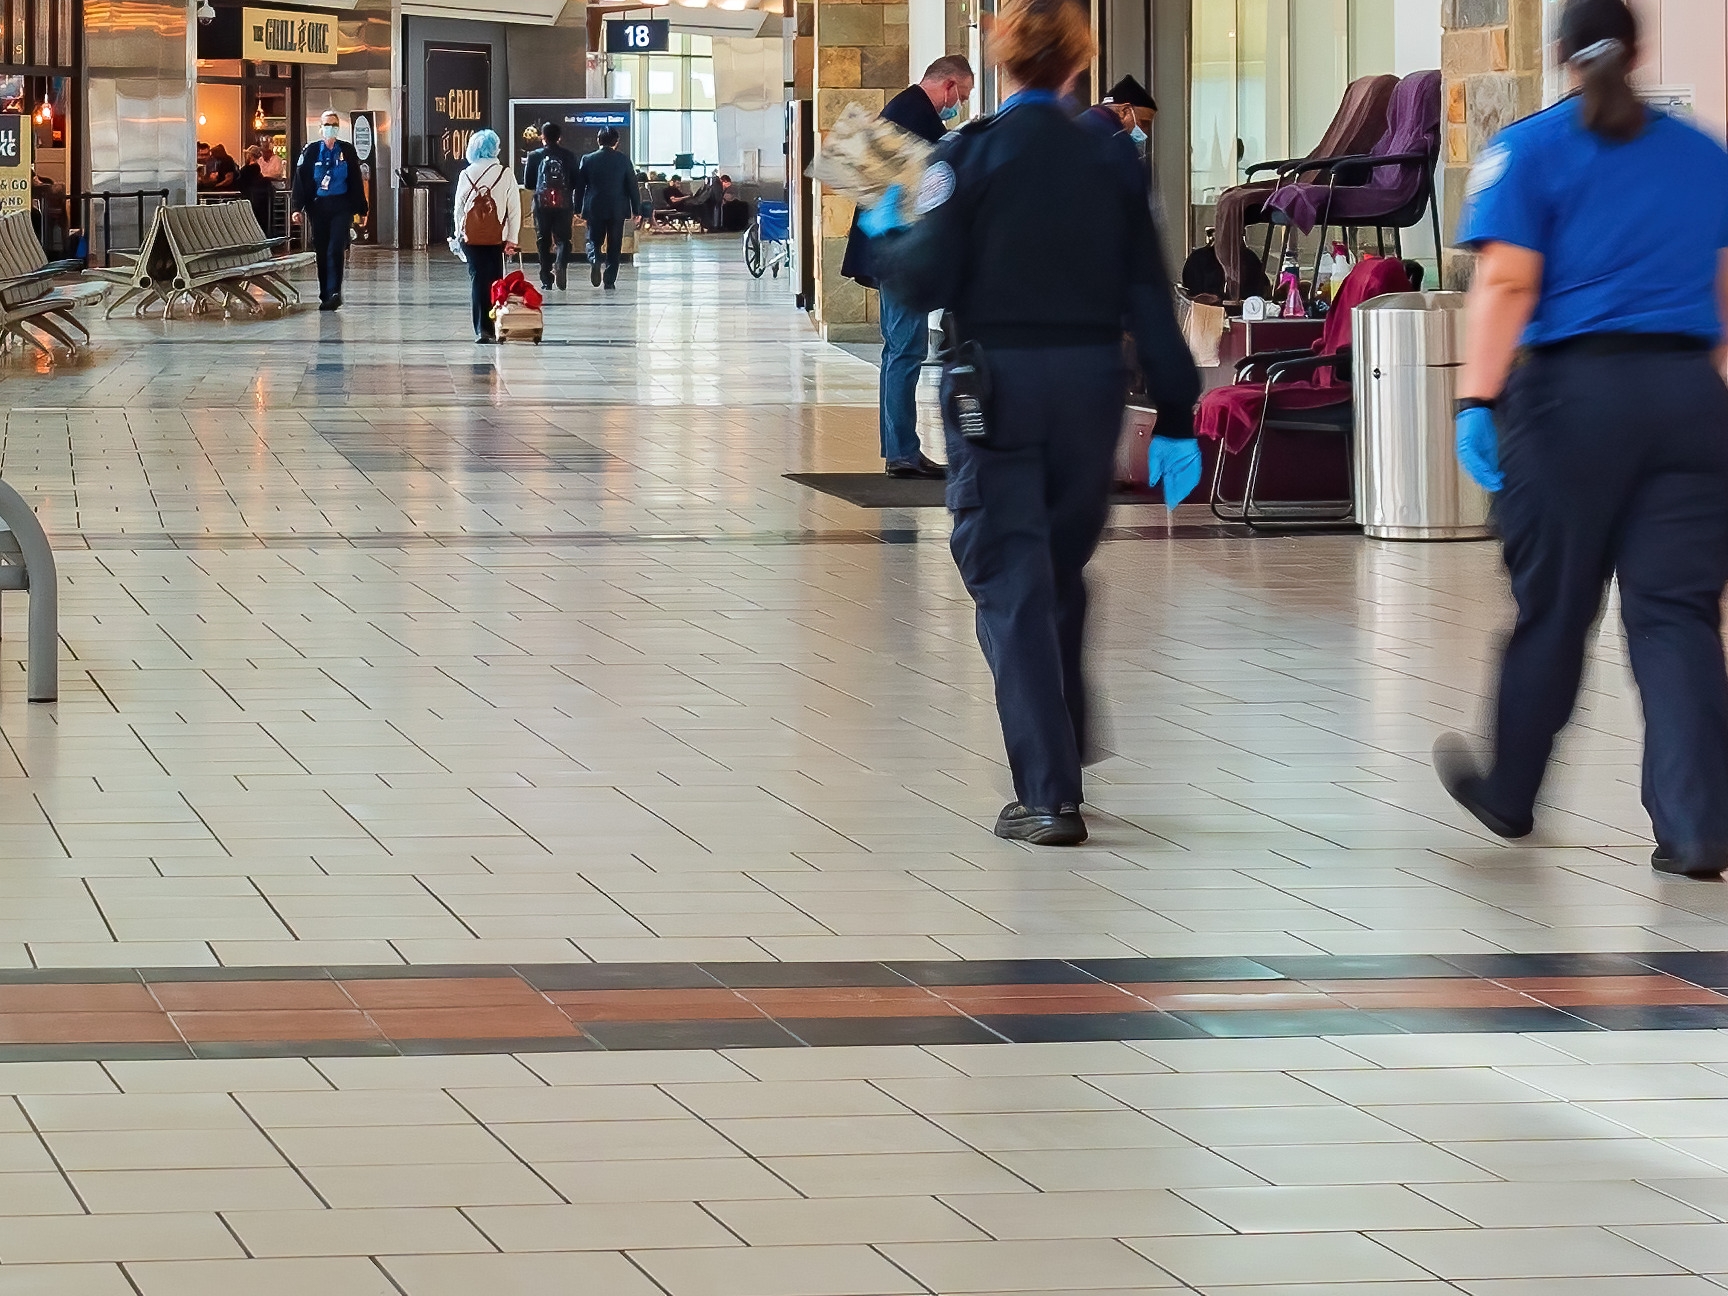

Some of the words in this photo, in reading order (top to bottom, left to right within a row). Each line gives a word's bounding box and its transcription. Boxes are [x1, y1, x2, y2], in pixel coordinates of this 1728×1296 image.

[266, 18, 297, 51] GRILL
[308, 21, 329, 54] OKC
[624, 25, 650, 48] 18
[449, 89, 481, 119] GRILL
[453, 129, 474, 160] OK
[0, 179, 8, 190] &
[12, 179, 27, 190] GO
